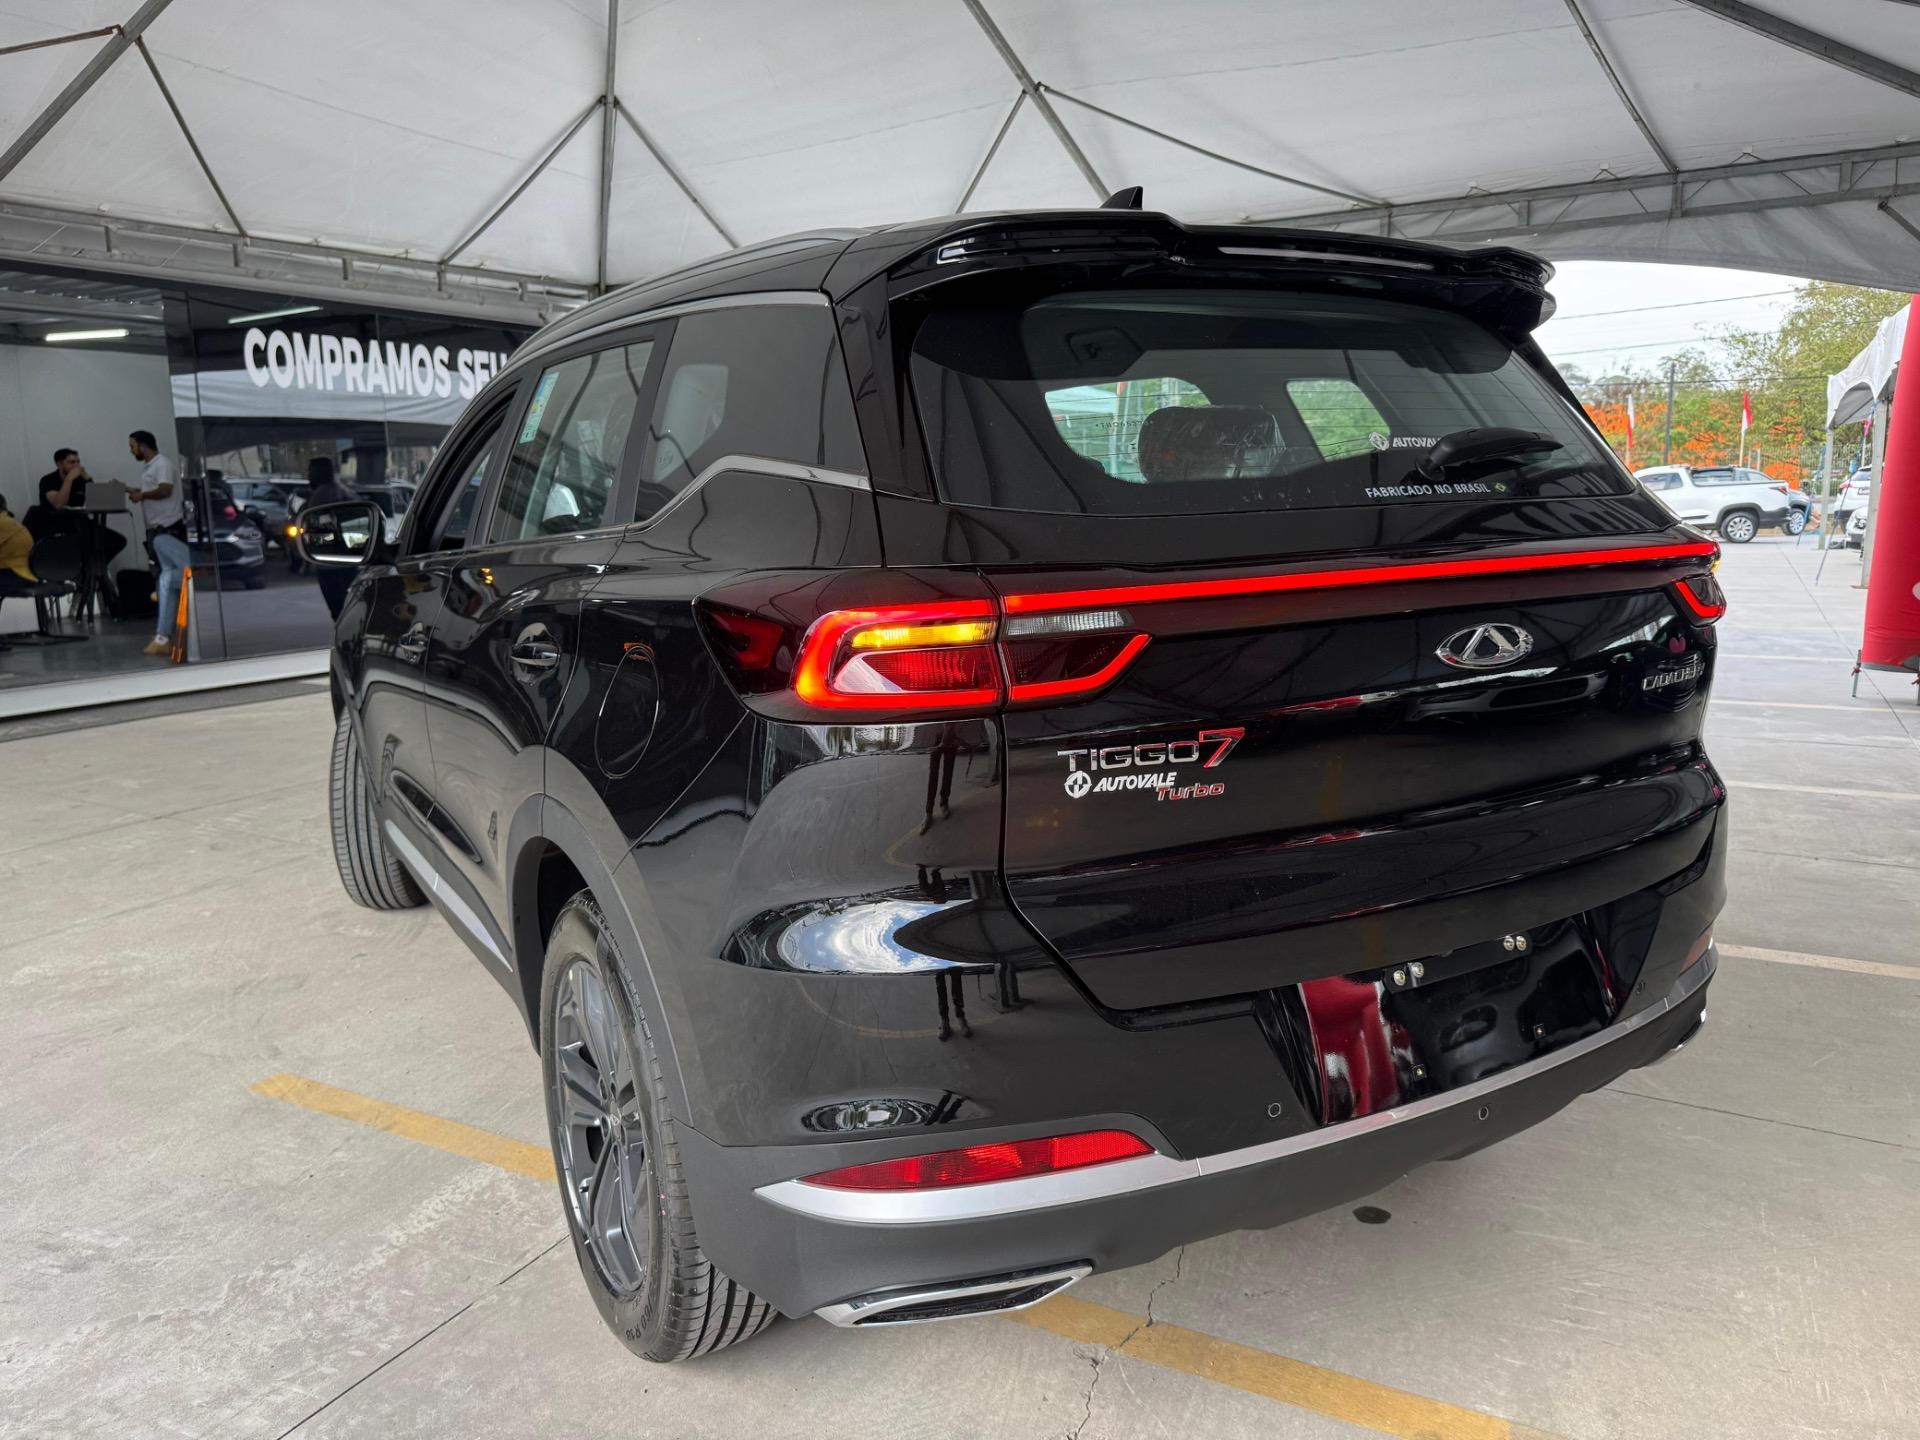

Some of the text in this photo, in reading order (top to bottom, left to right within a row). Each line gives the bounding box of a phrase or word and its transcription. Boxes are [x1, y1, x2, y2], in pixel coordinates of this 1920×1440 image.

[243, 327, 452, 399] COMPRAMOS
[1365, 483, 1491, 498] FABRICADO NO BRASIL
[1092, 771, 1178, 793] AUTOVALE
[1156, 782, 1226, 802] Turbo
